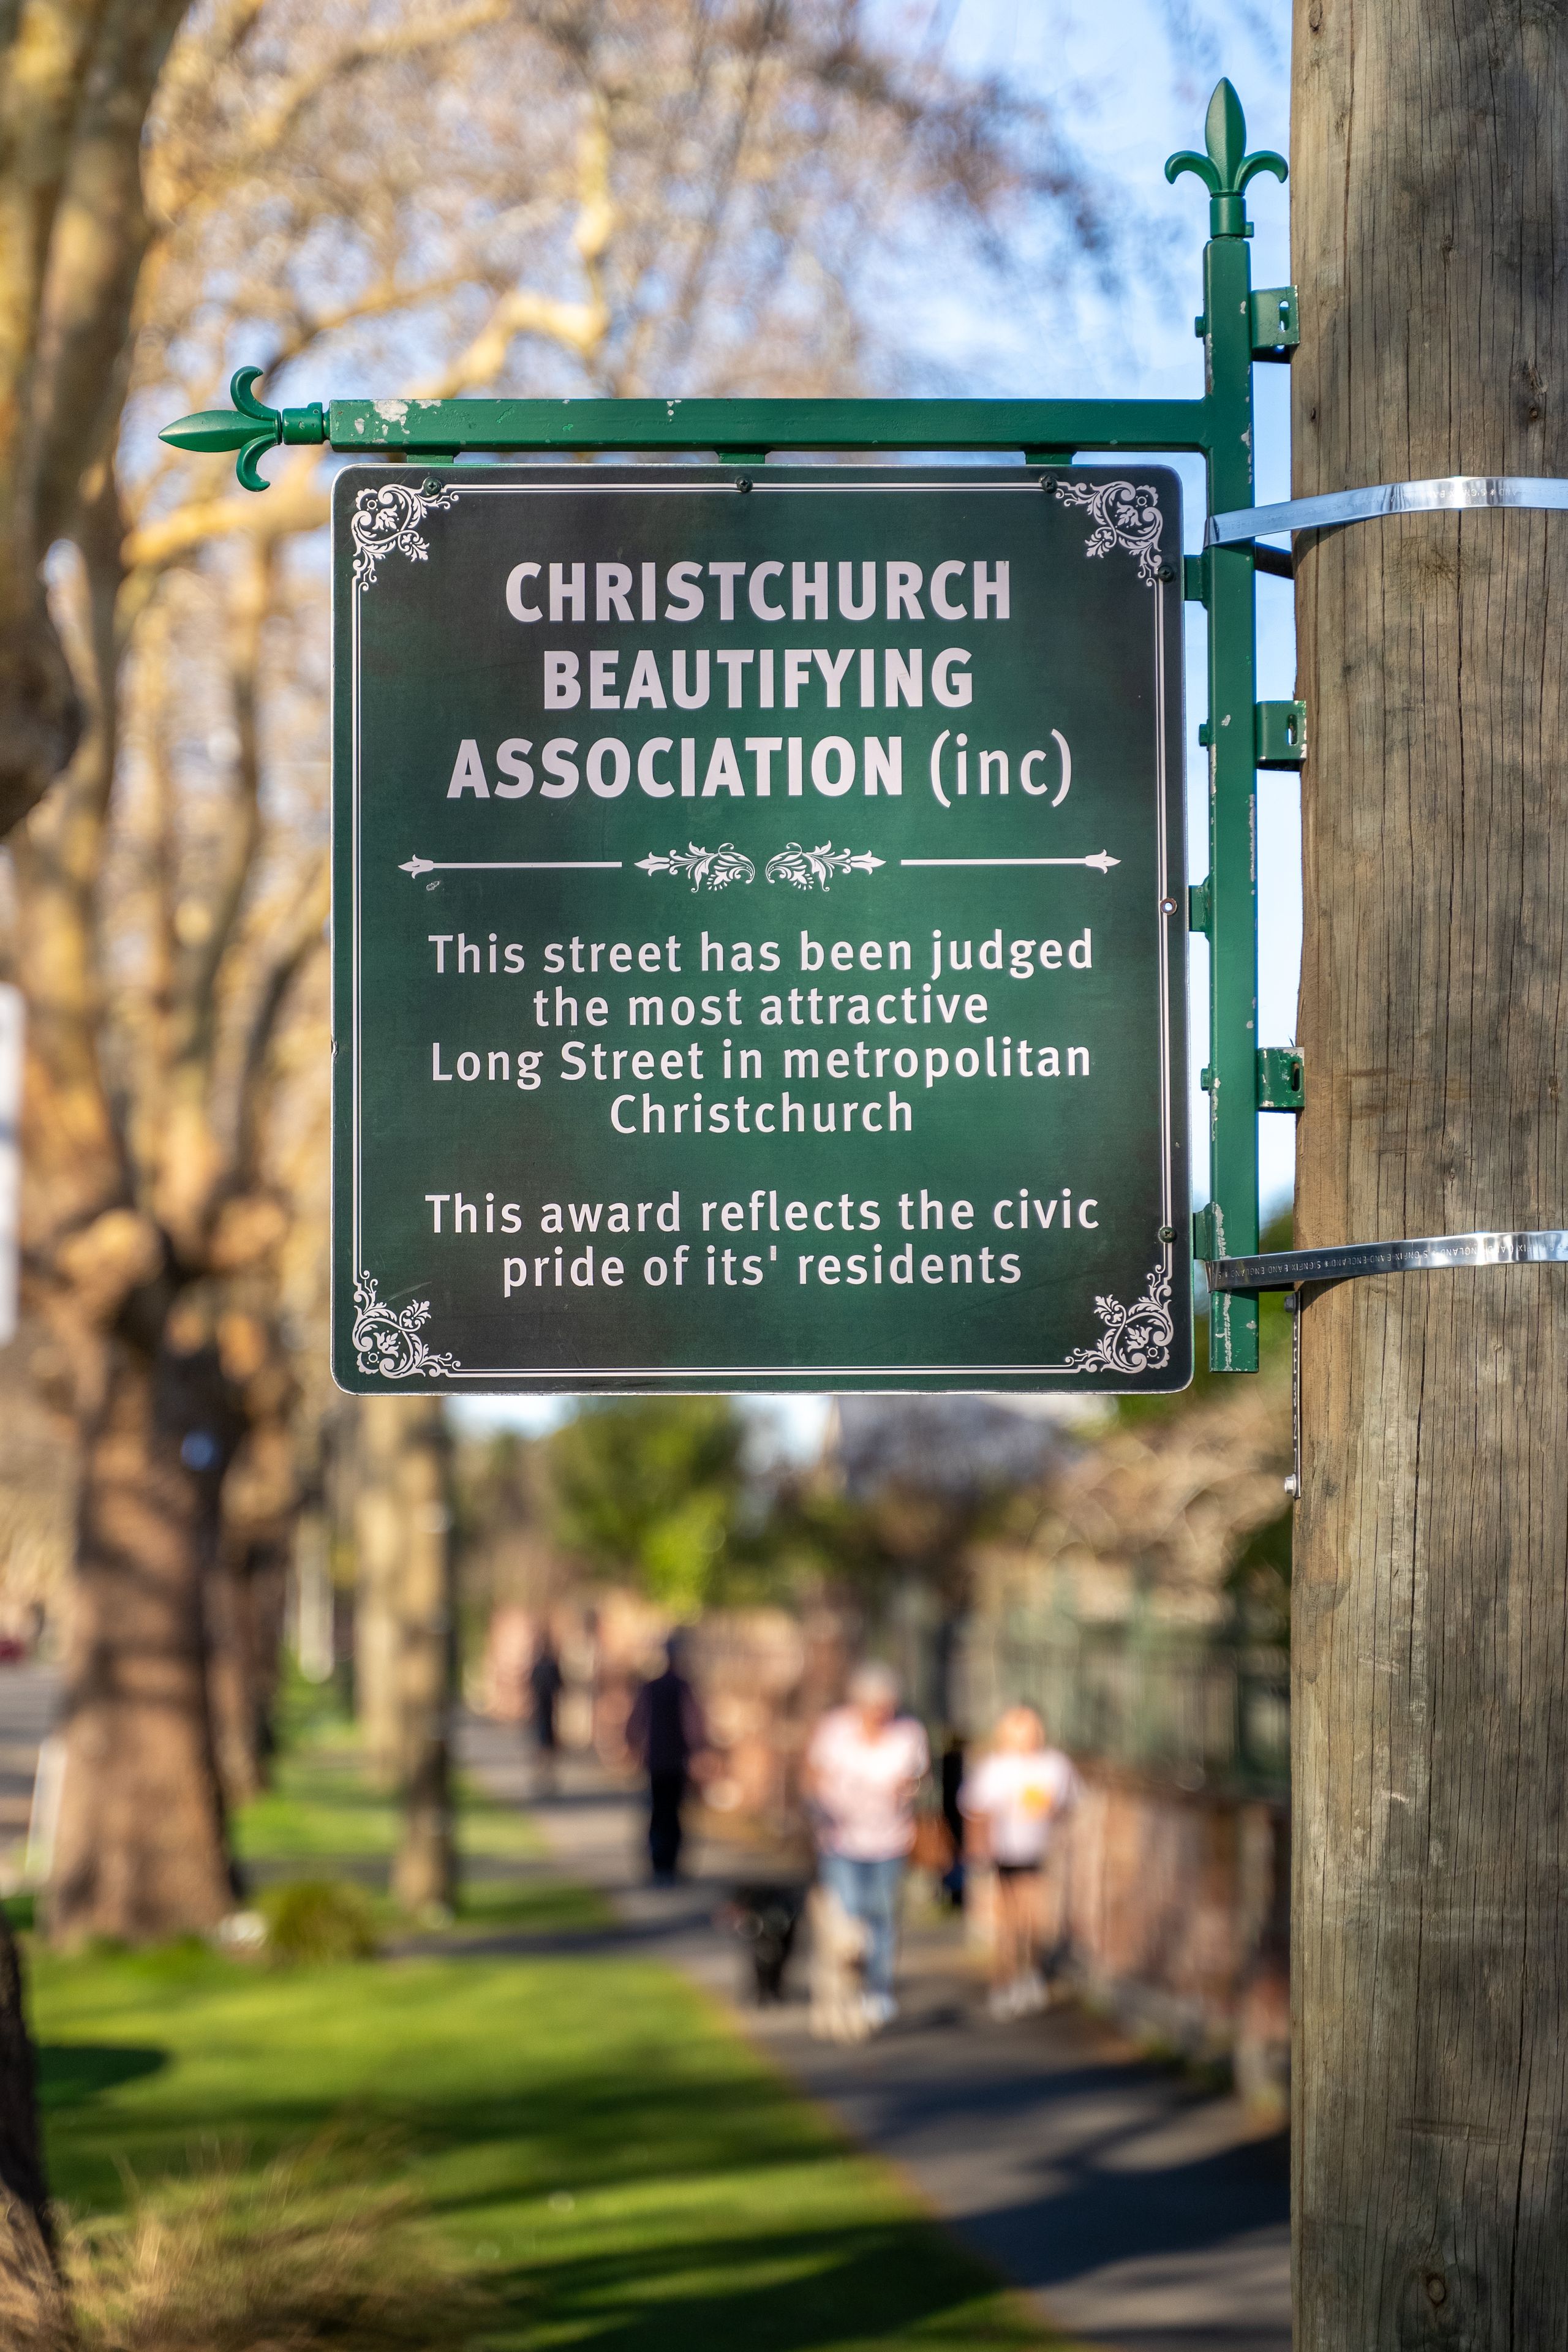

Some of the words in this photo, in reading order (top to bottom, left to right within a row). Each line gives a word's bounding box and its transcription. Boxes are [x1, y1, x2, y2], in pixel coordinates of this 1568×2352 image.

[506, 560, 1010, 622] CHRISTCHURCH
[545, 648, 973, 709] BEAUTIFYING
[447, 736, 902, 798] ASSOCIATION
[930, 729, 1072, 808] (inc)
[429, 933, 525, 973] This
[544, 935, 682, 973] street
[701, 931, 780, 971] has
[801, 930, 911, 971] been
[924, 928, 1093, 980] judged
[533, 986, 609, 1027] the
[629, 989, 742, 1025] most
[761, 983, 988, 1025] attractive
[433, 1042, 543, 1090] Long
[560, 1041, 704, 1080] Street
[723, 1039, 762, 1078] in
[784, 1036, 1090, 1088] metropolitan
[611, 1090, 912, 1134] Christchurch
[425, 1193, 522, 1233] This
[541, 1191, 680, 1233] award
[702, 1190, 881, 1231] reflects
[899, 1189, 974, 1230] the
[994, 1188, 1099, 1229] civic
[504, 1246, 624, 1298] pride
[644, 1245, 690, 1286] of
[707, 1245, 777, 1285] its'
[799, 1243, 1021, 1284] residents
[1440, 1246, 1477, 1256] NGLAND
